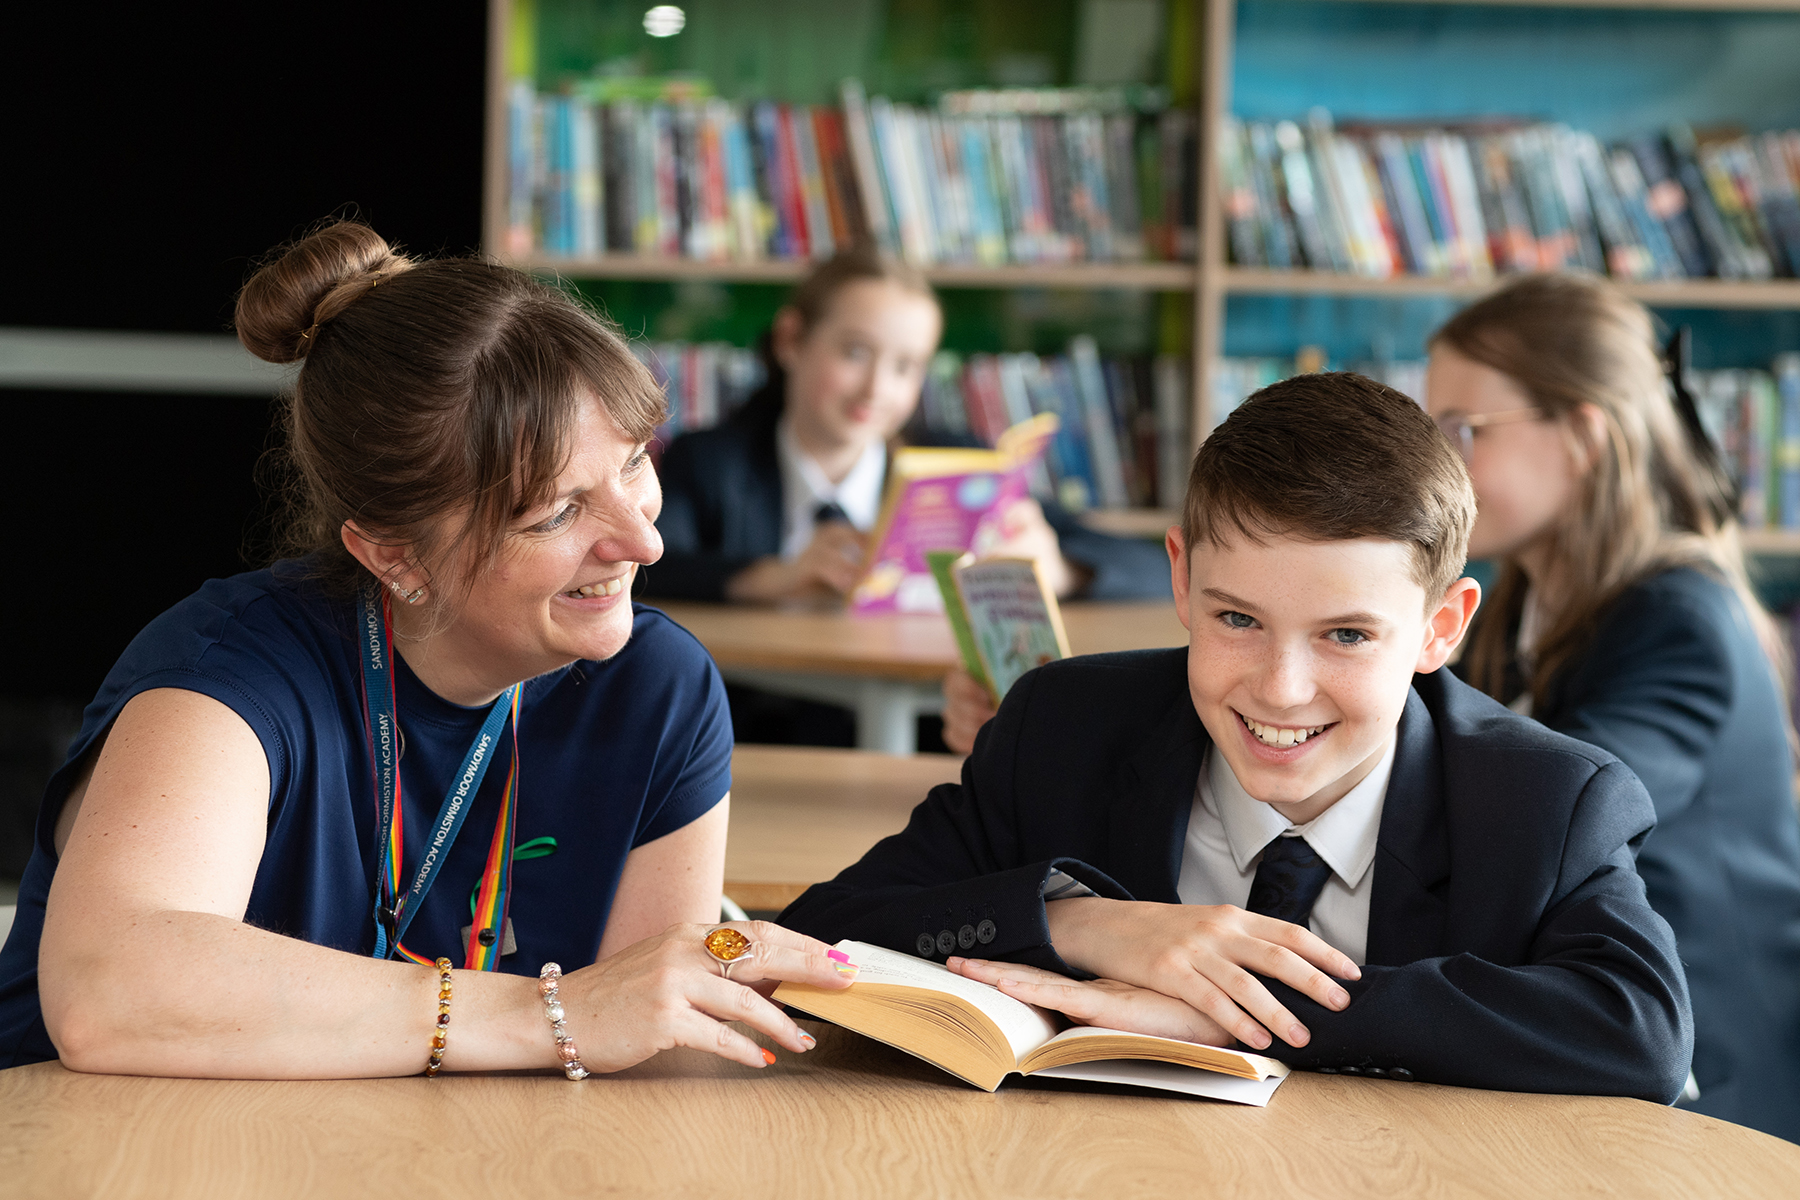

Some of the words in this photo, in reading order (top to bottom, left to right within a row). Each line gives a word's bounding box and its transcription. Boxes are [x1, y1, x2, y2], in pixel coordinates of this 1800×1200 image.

[366, 601, 383, 670] SANDYMOOR
[378, 713, 391, 766] ACADEMY
[456, 733, 491, 797] SANDYMOOR
[382, 768, 391, 824] ORMISTON
[434, 795, 464, 848] ORMISTON
[375, 825, 388, 886] YMOOR
[412, 847, 439, 894] ACADEMY
